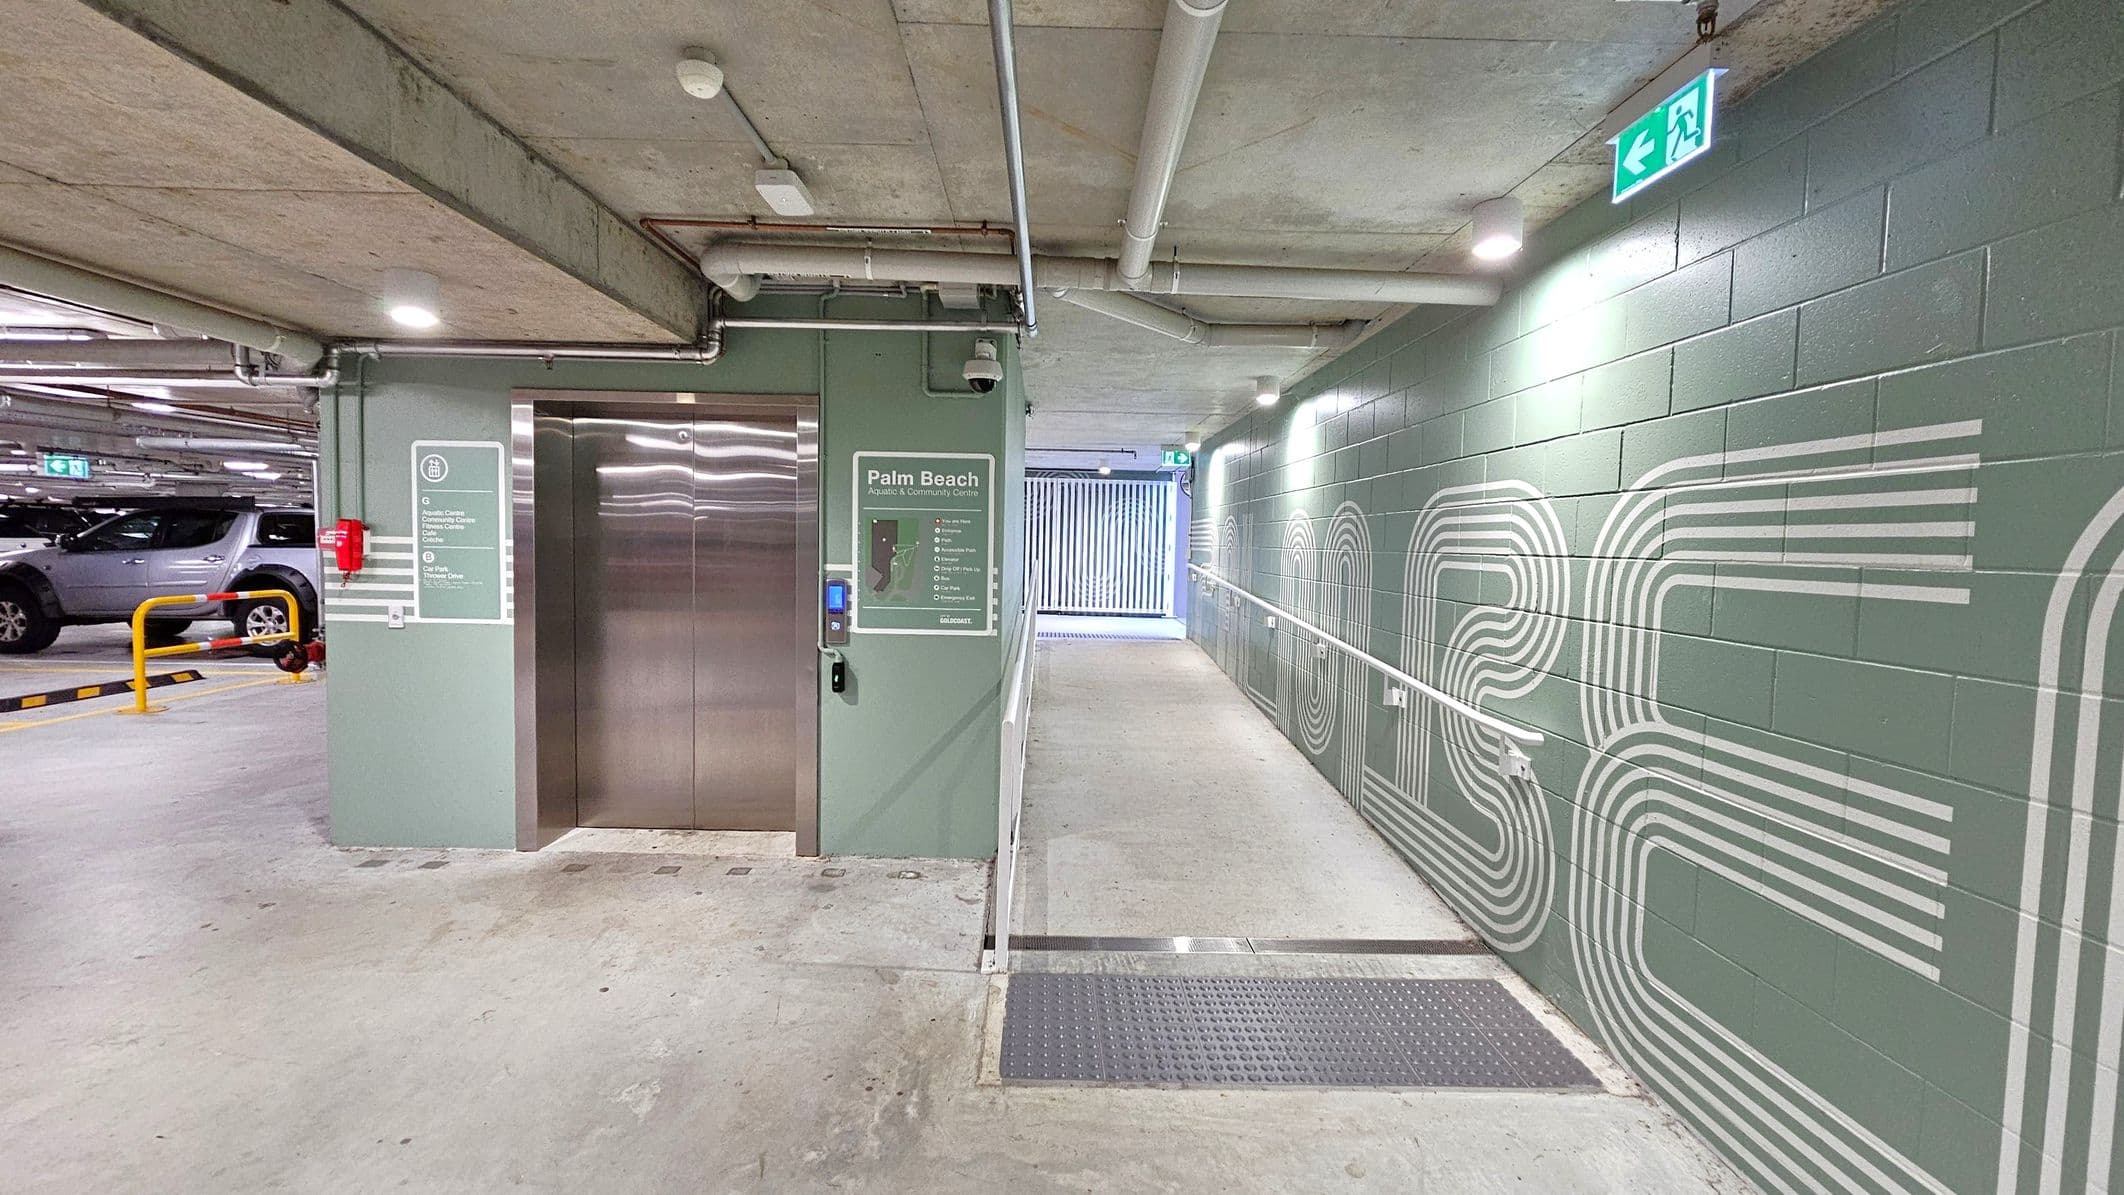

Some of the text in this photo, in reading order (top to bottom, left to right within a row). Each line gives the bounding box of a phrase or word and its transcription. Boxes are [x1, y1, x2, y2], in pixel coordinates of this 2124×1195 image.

[867, 469, 979, 487] Palm Beach
[867, 487, 979, 498] Aquatic & Community Centre
[422, 496, 430, 505] G
[422, 516, 455, 524] Community
